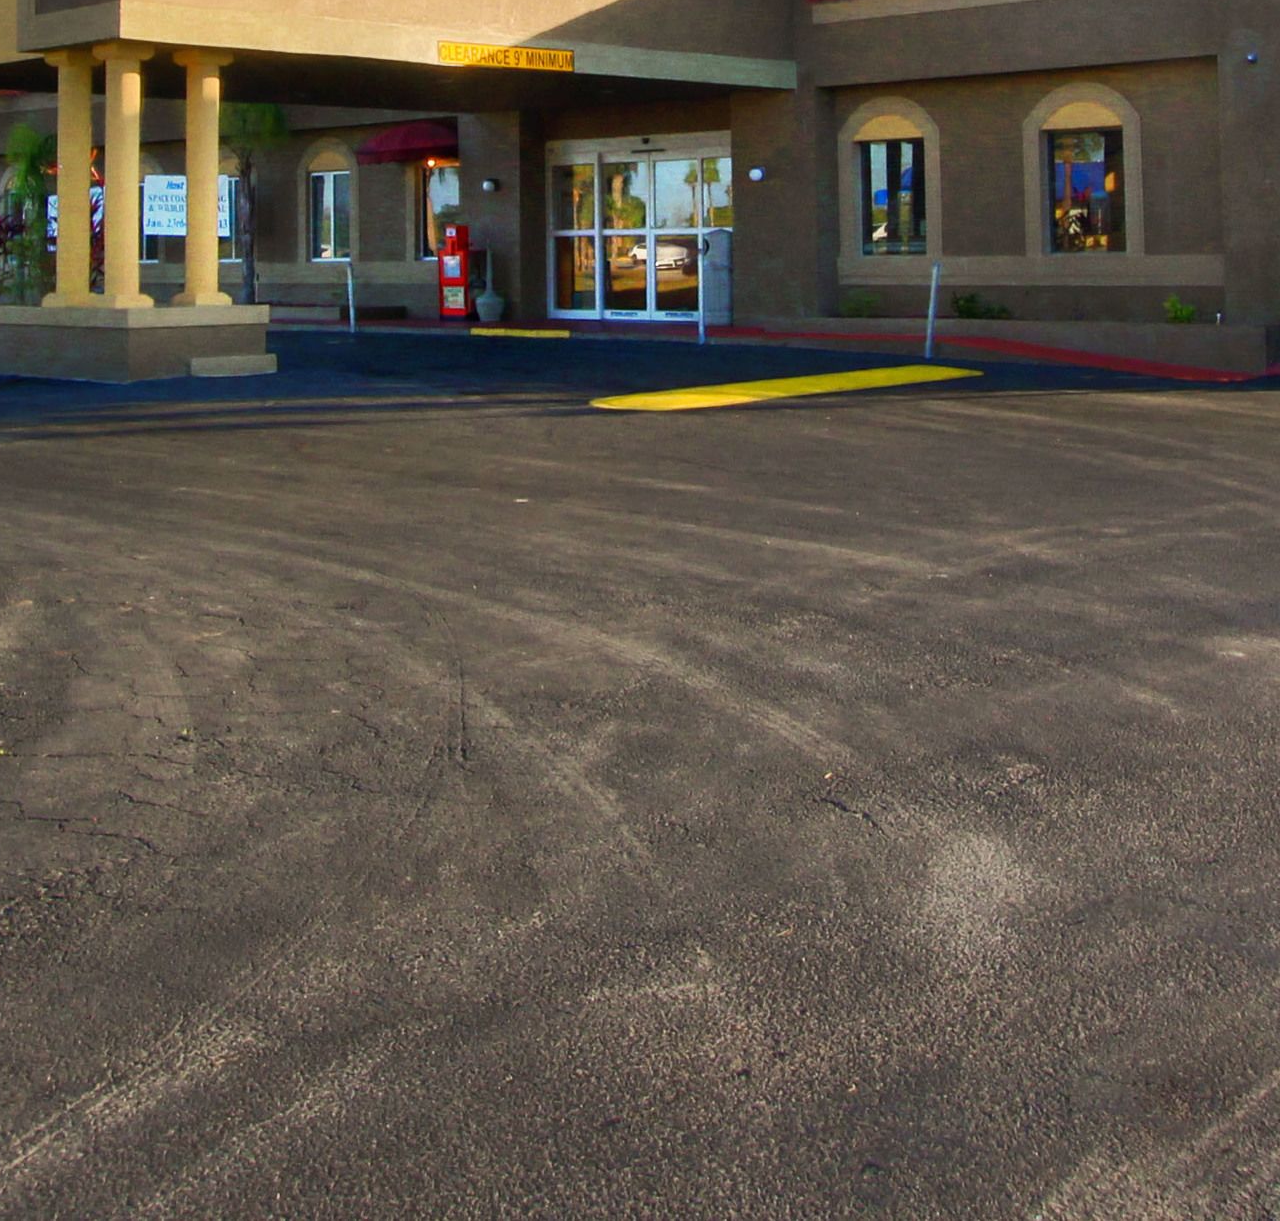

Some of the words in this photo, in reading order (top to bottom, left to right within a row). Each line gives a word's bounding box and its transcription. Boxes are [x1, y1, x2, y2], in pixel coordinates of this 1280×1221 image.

[440, 43, 511, 65] CLEARANCE
[526, 50, 573, 69] MINIMUM
[169, 195, 186, 203] COA
